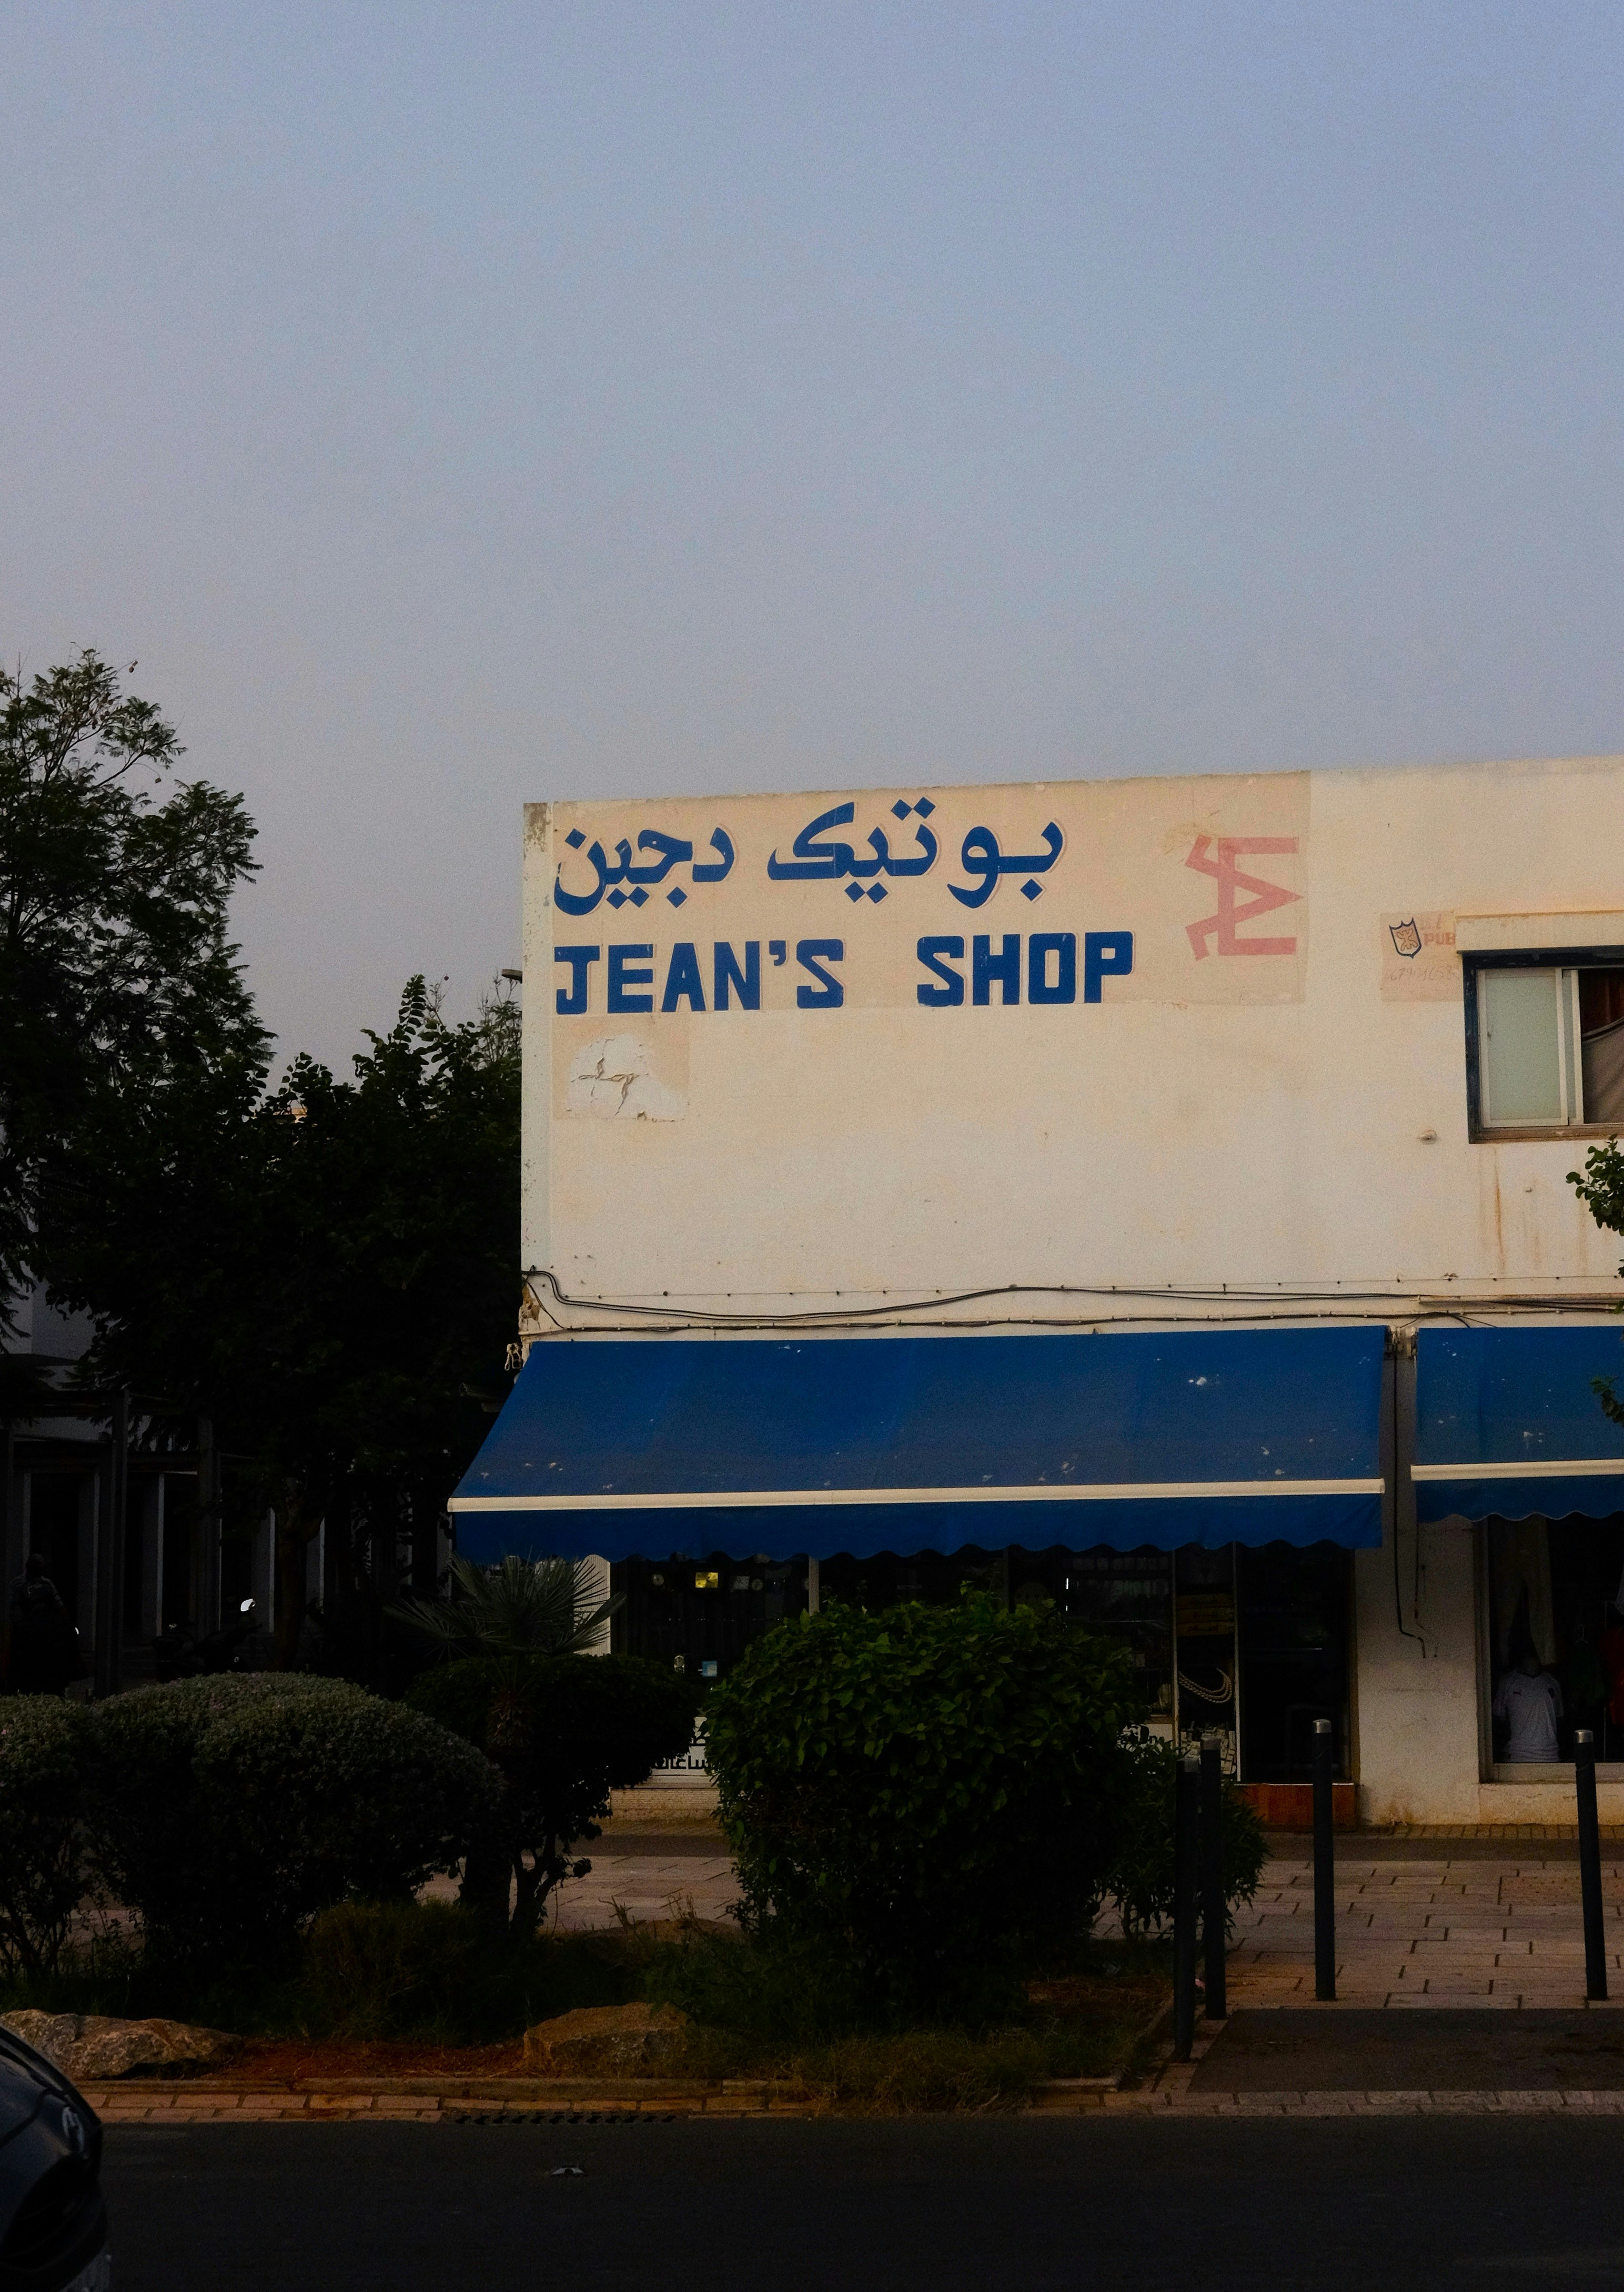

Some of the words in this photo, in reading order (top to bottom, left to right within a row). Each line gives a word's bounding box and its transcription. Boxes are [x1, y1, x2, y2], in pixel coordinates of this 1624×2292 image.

[768, 797, 1063, 908] بوتيك
[554, 939, 843, 1014] JEAN'S
[917, 932, 1133, 1007] SHOP
